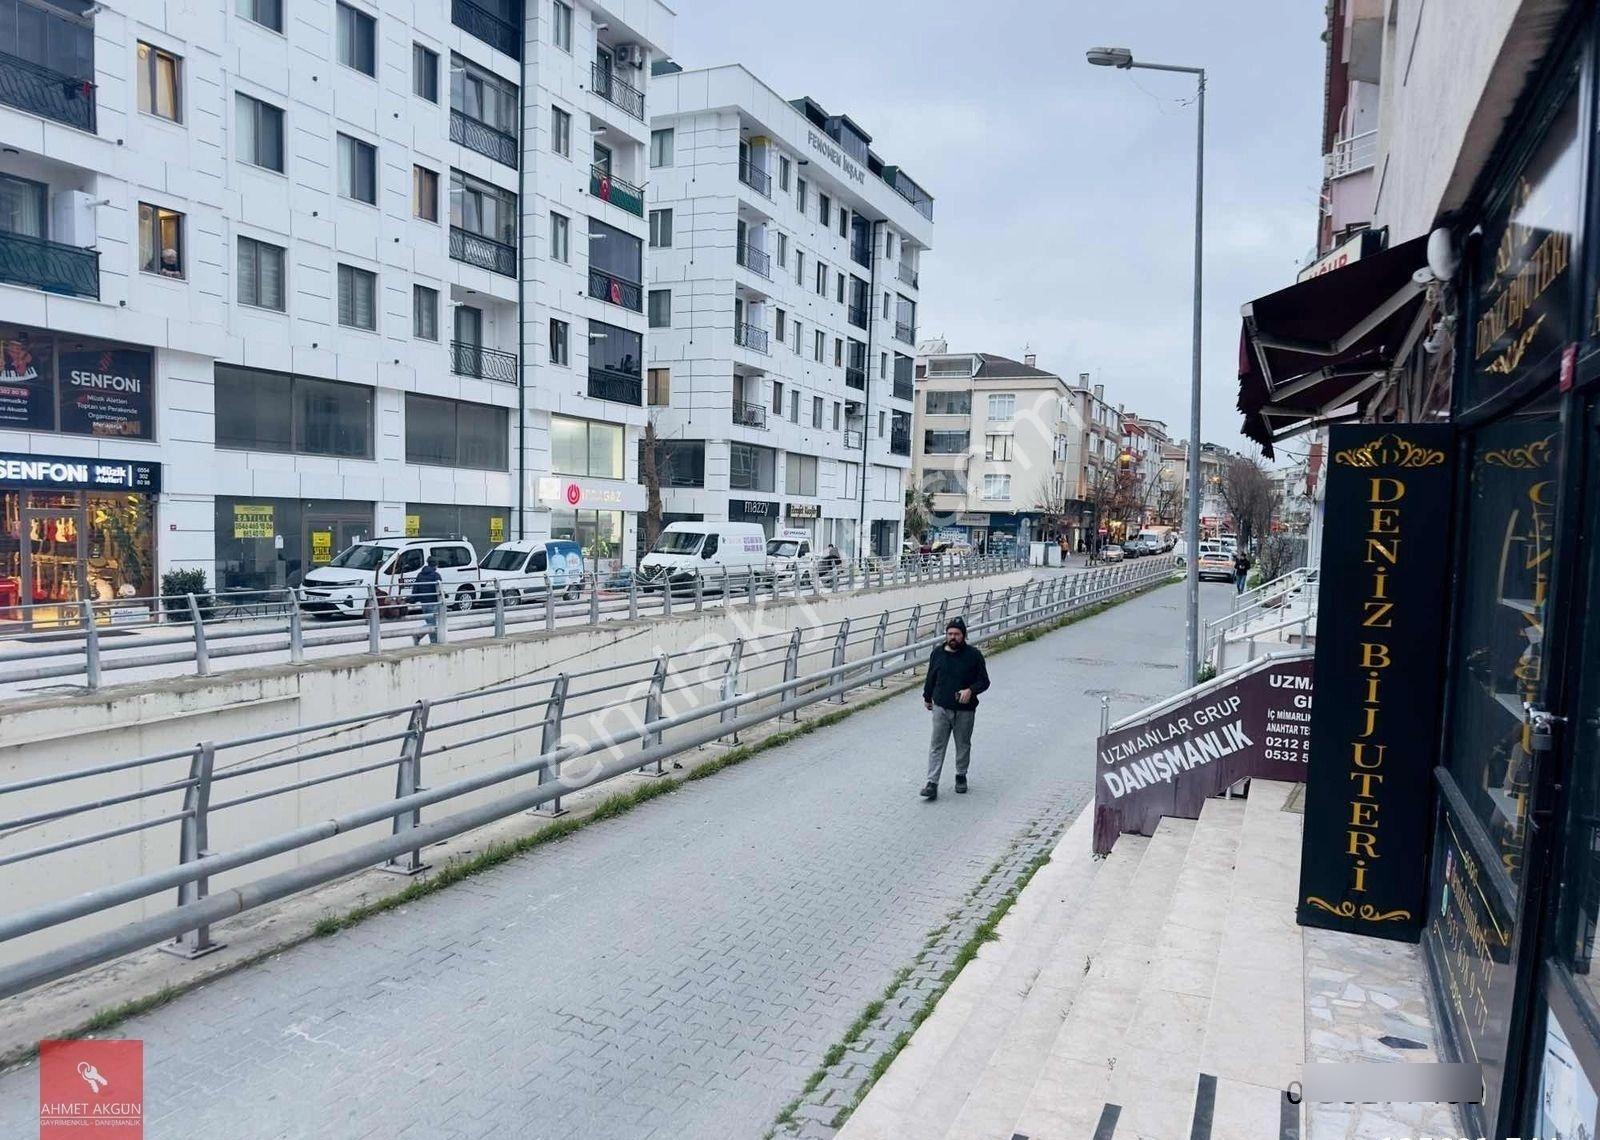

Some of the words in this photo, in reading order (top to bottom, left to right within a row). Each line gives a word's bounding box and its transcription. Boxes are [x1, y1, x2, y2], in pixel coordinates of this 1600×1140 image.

[744, 501, 769, 517] mazzy
[1361, 477, 1406, 628] DENİZ
[1101, 717, 1194, 765] UZMANLAR
[1193, 695, 1242, 726] GRUP
[1265, 722, 1299, 736] ANAHTAR
[1265, 736, 1299, 750] 0212
[1103, 719, 1255, 799] DANIŞMANLIK
[1264, 749, 1298, 762] 0532
[1345, 642, 1392, 892] BİJUTERİ
